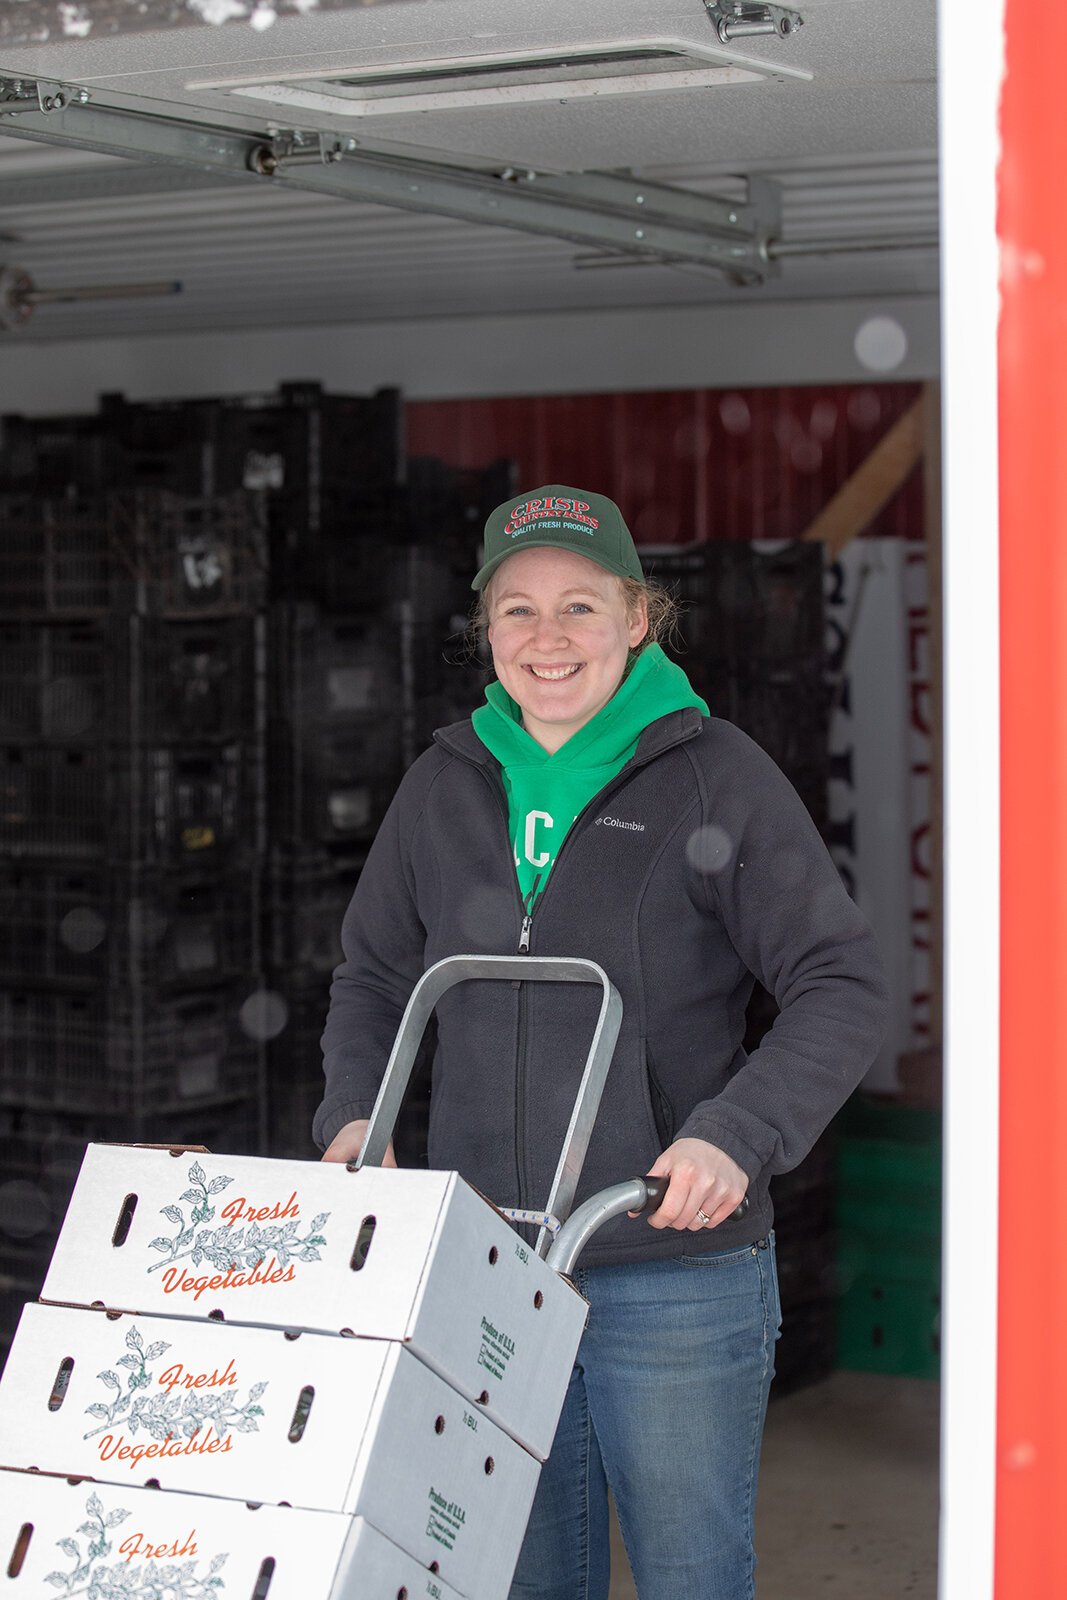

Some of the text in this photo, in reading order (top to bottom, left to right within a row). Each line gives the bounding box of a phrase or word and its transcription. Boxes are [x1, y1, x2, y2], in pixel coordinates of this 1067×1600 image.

[504, 510, 599, 535] COUNTRY ACRES
[511, 497, 590, 519] CRISP
[511, 521, 594, 538] QUALITY FRESH PRODUCE
[603, 816, 645, 831] Columbia
[220, 1191, 300, 1227] Fresh
[161, 1257, 296, 1301] Vegetables
[158, 1358, 238, 1393] Fresh
[98, 1426, 234, 1470] Vegetables
[118, 1529, 198, 1563] Fresh
